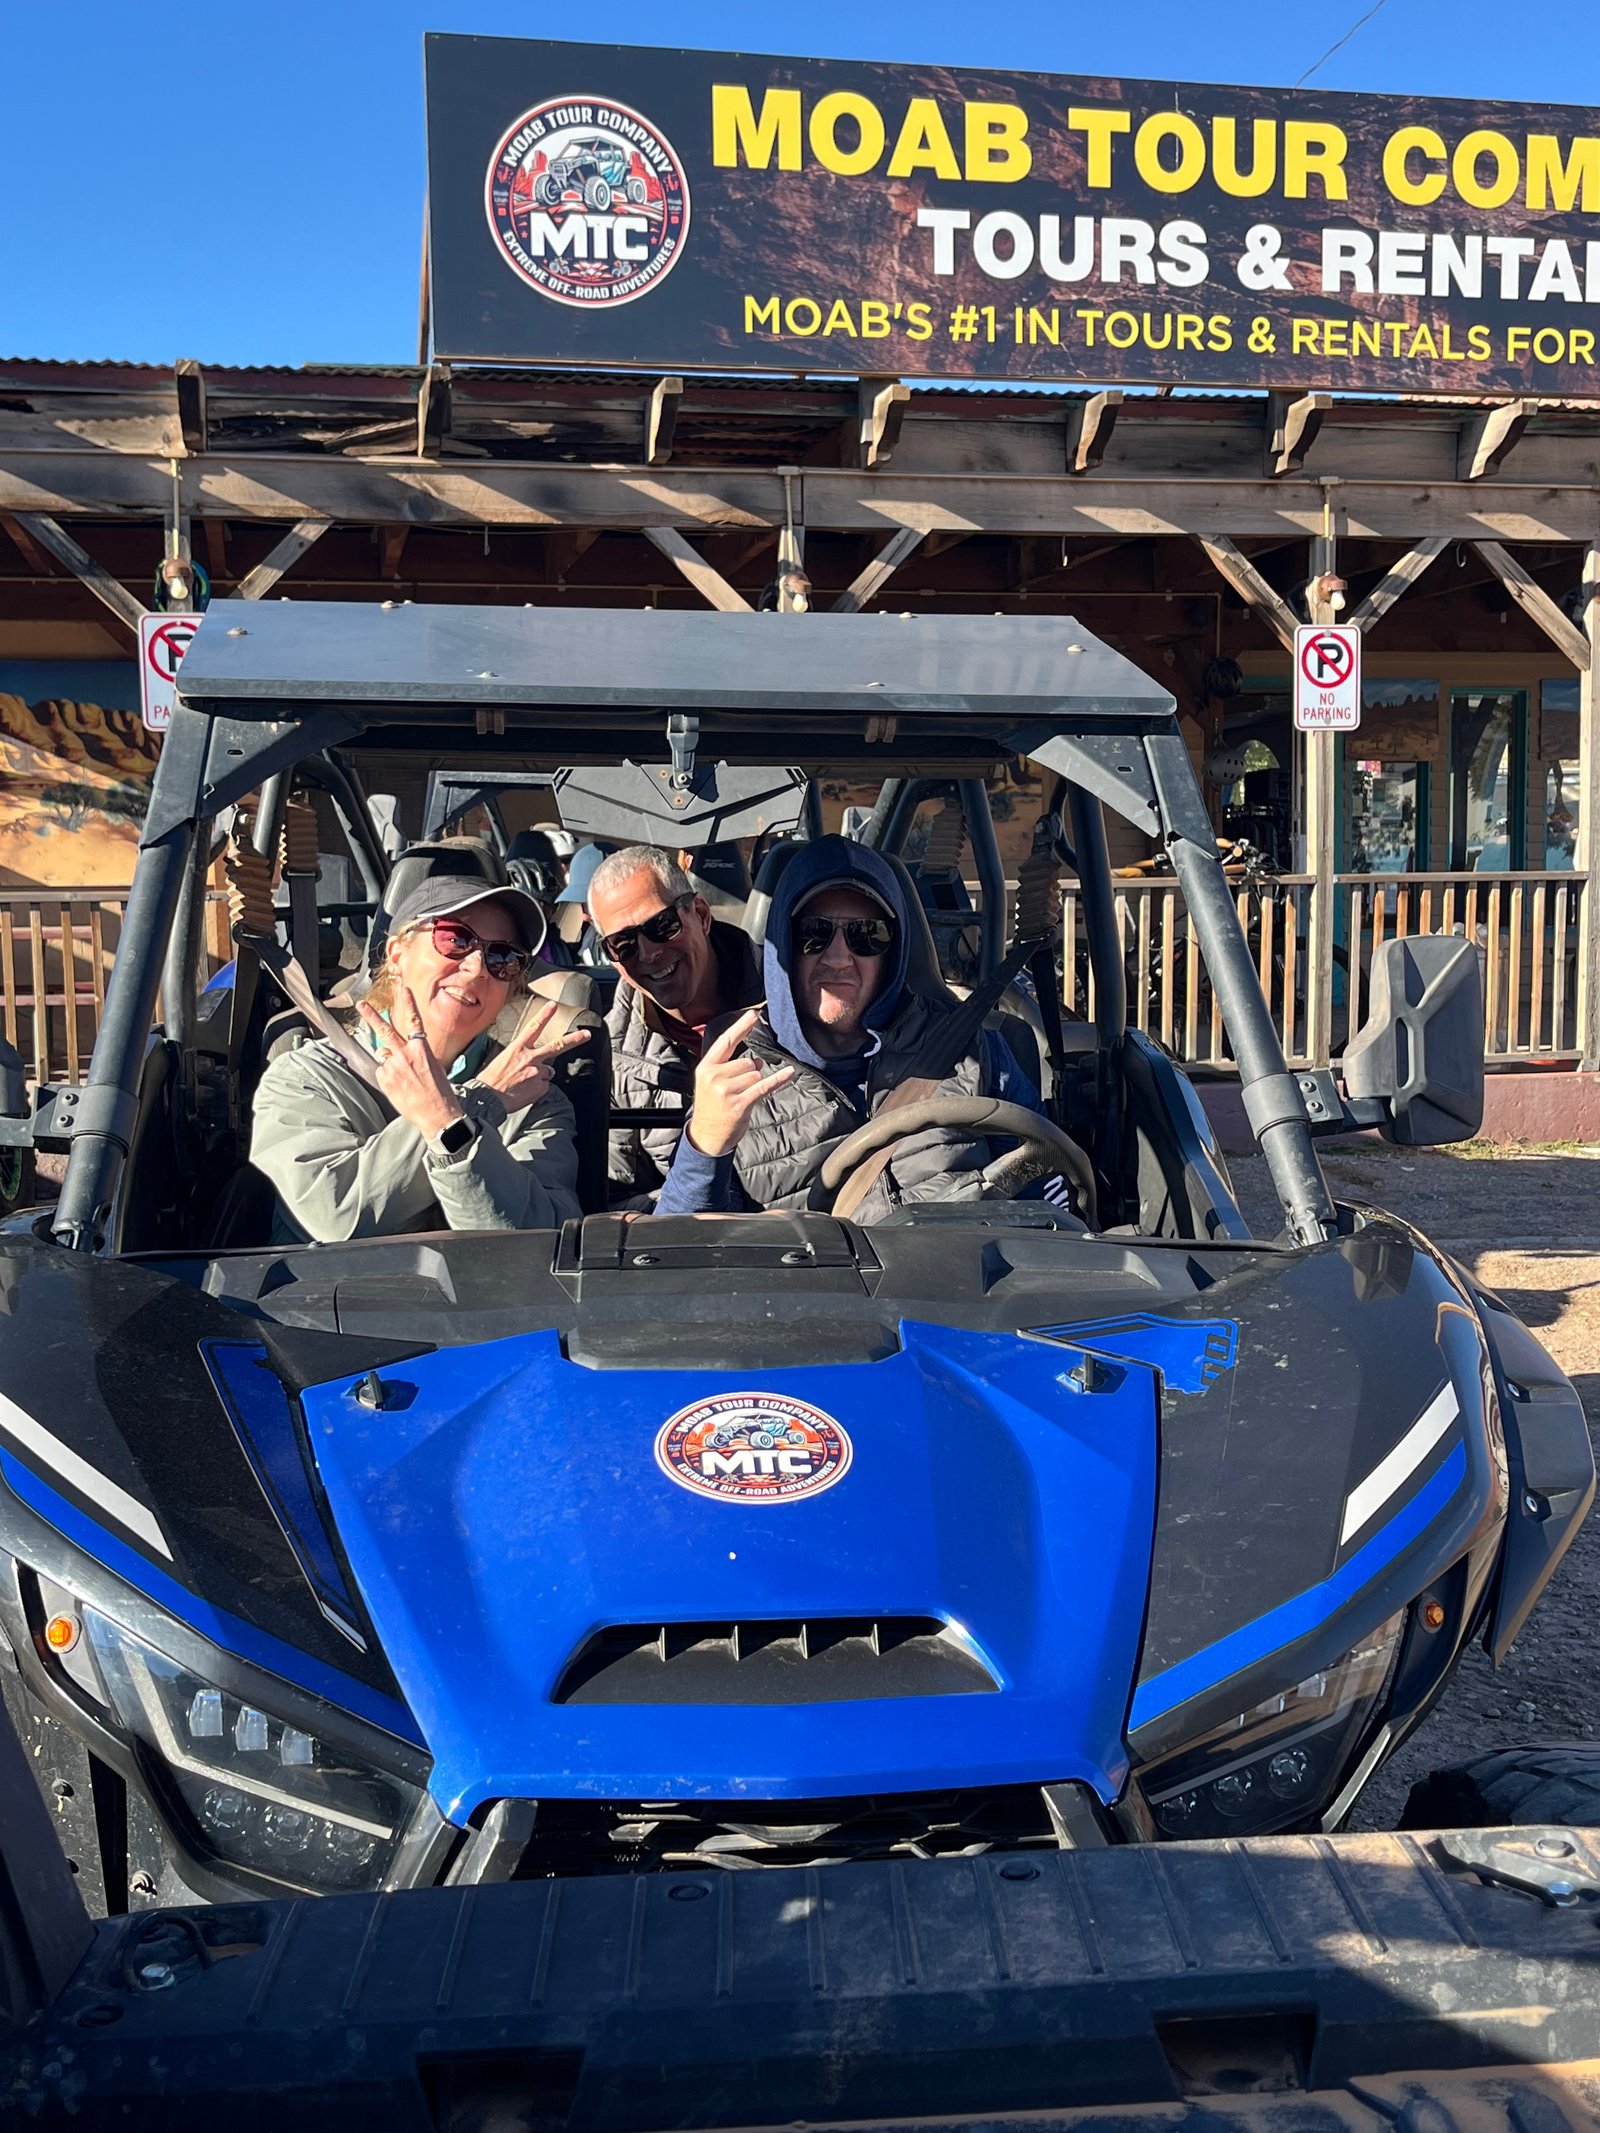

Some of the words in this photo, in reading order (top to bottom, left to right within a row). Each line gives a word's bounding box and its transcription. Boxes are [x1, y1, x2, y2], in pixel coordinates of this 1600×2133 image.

[503, 121, 547, 168] MOAB
[545, 106, 593, 129] TOUR
[597, 109, 674, 173] COMPANY
[713, 85, 1033, 183] MOAB
[1068, 108, 1348, 201] TOUR
[1383, 127, 1600, 213] COM
[530, 211, 649, 261] MTC
[916, 207, 1210, 287] TOURS
[1237, 224, 1294, 291] &
[502, 230, 549, 284] EXTREME
[547, 277, 611, 300] OFF-ROAD
[612, 237, 677, 298] ADVENTURES
[745, 297, 932, 341] MOAB'S
[950, 306, 995, 341] #1
[1016, 309, 1059, 344] IN
[1078, 310, 1233, 351] TOURS
[1248, 318, 1275, 353] &
[1293, 319, 1492, 361] RENTALS
[1508, 328, 1595, 364] FOR
[1303, 707, 1351, 720] PARKING
[1319, 692, 1335, 706] NO
[676, 1408, 713, 1432] MOAB
[712, 1399, 755, 1412] TOUR
[758, 1399, 830, 1431] COMPANY
[676, 1462, 717, 1489] EXTREME
[720, 1483, 778, 1496] OFF-ROAD
[780, 1460, 837, 1494] ADVENTURES
[701, 1449, 813, 1476] MTC
